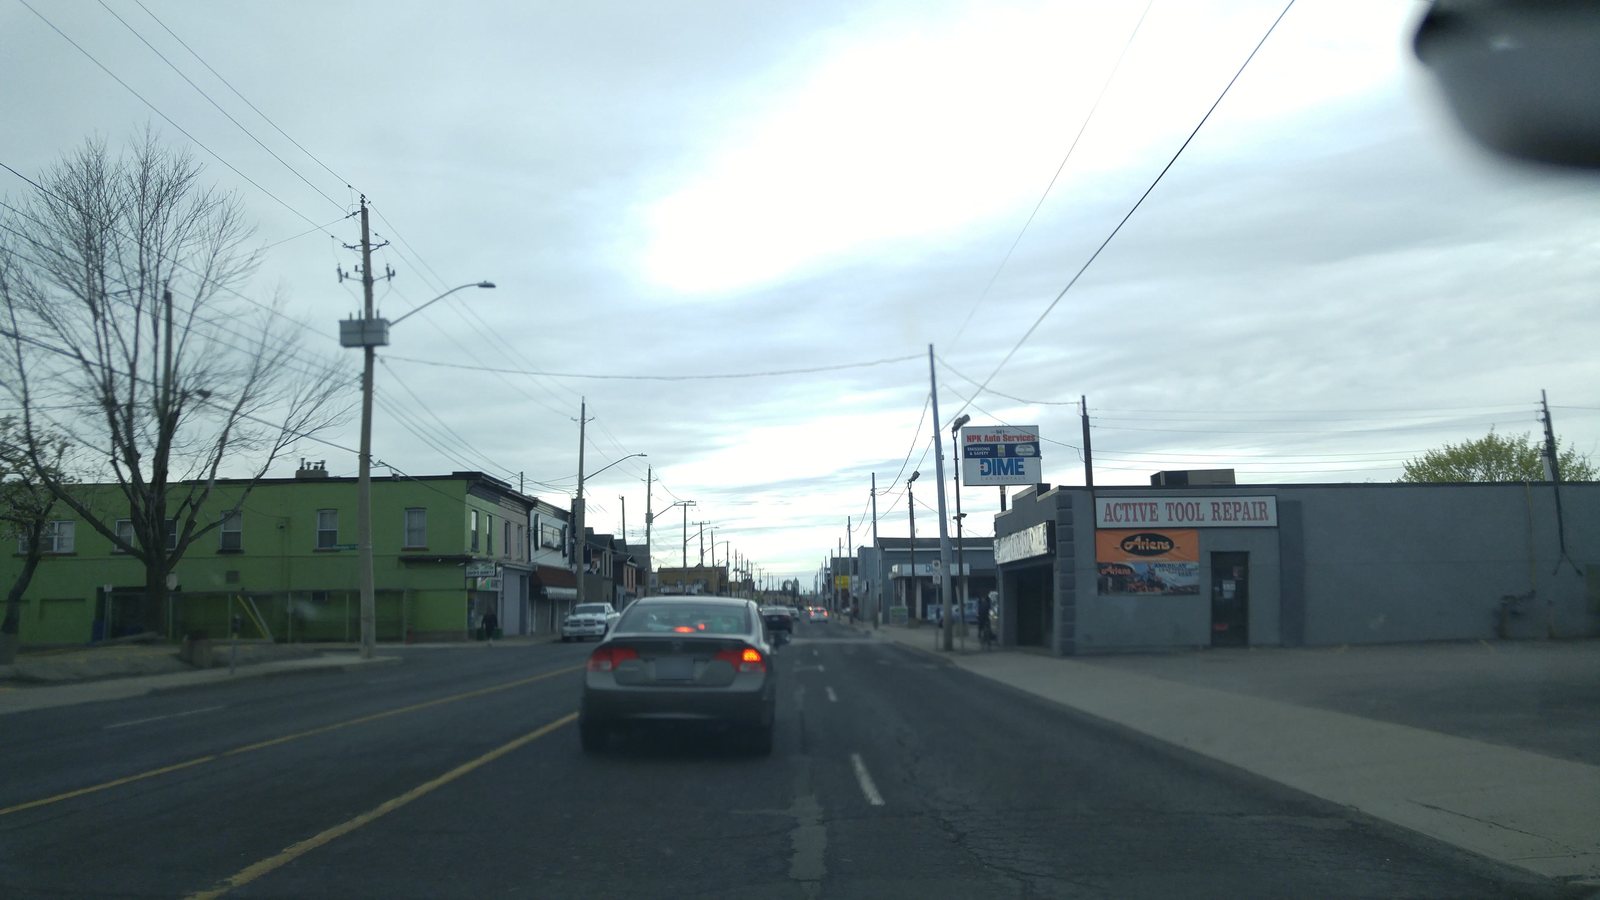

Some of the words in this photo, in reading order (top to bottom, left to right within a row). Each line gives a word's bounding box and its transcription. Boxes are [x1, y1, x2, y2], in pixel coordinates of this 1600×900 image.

[966, 434, 982, 442] NPK
[984, 434, 1001, 442] Auto
[1003, 433, 1036, 442] Services
[980, 457, 1025, 476] DIME
[1103, 502, 1159, 523] ACTIVE
[1165, 501, 1205, 522] TOOL
[1210, 501, 1269, 522] REPAIR
[1123, 535, 1170, 551] Ariens
[1100, 565, 1132, 576] Ariens
